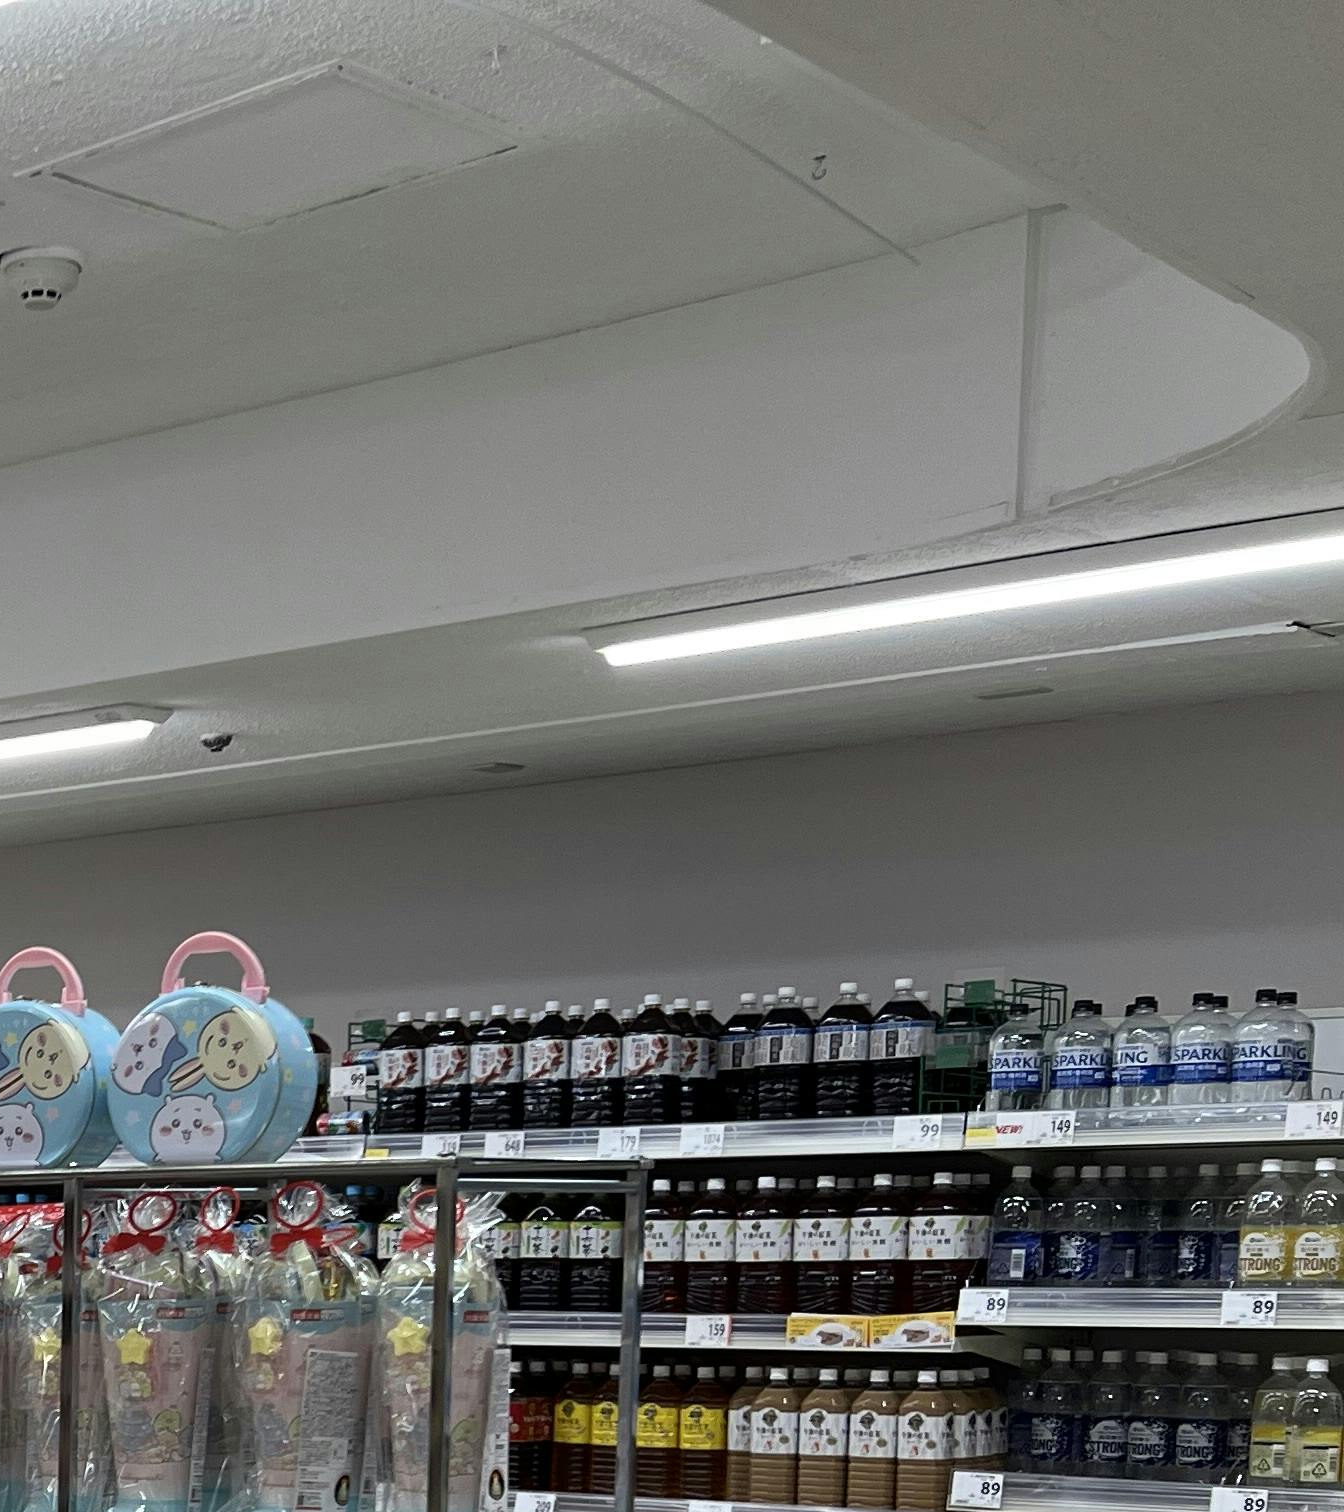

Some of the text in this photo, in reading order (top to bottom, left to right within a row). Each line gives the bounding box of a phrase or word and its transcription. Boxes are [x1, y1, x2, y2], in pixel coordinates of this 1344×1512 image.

[1317, 1111, 1338, 1126] 149
[920, 1124, 939, 1138] 99
[1051, 1120, 1071, 1134] 149
[621, 1136, 636, 1149] 179
[986, 1297, 1005, 1311] 89
[1253, 1300, 1274, 1314] 89
[708, 1322, 724, 1337] 159
[981, 1482, 1001, 1496] 89
[1243, 1497, 1265, 1512] 89
